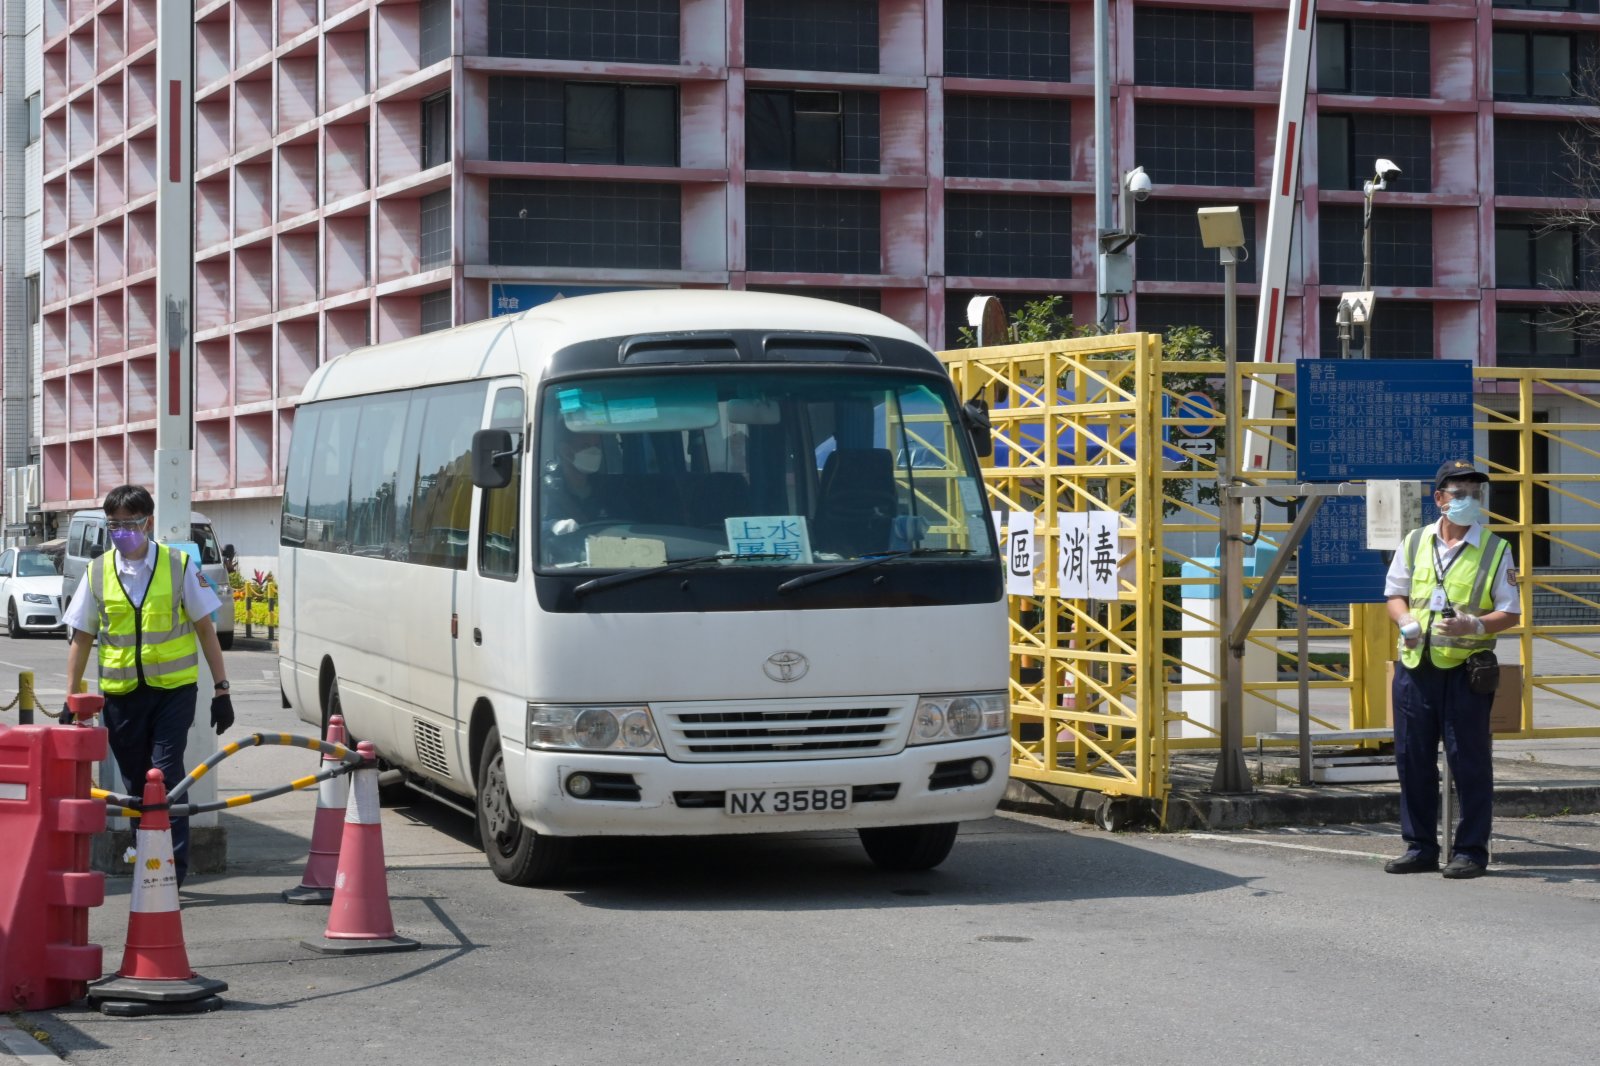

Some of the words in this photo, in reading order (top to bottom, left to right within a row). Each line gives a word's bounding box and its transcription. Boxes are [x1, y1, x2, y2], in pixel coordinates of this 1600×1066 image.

[497, 297, 519, 309] 貨倉
[1309, 363, 1337, 380] 警告
[732, 520, 800, 540] 上水
[735, 541, 802, 562] 屠房
[1011, 529, 1031, 576] 區
[1063, 525, 1117, 584] 消毒
[731, 791, 766, 814] NX
[773, 789, 847, 812] 3588
